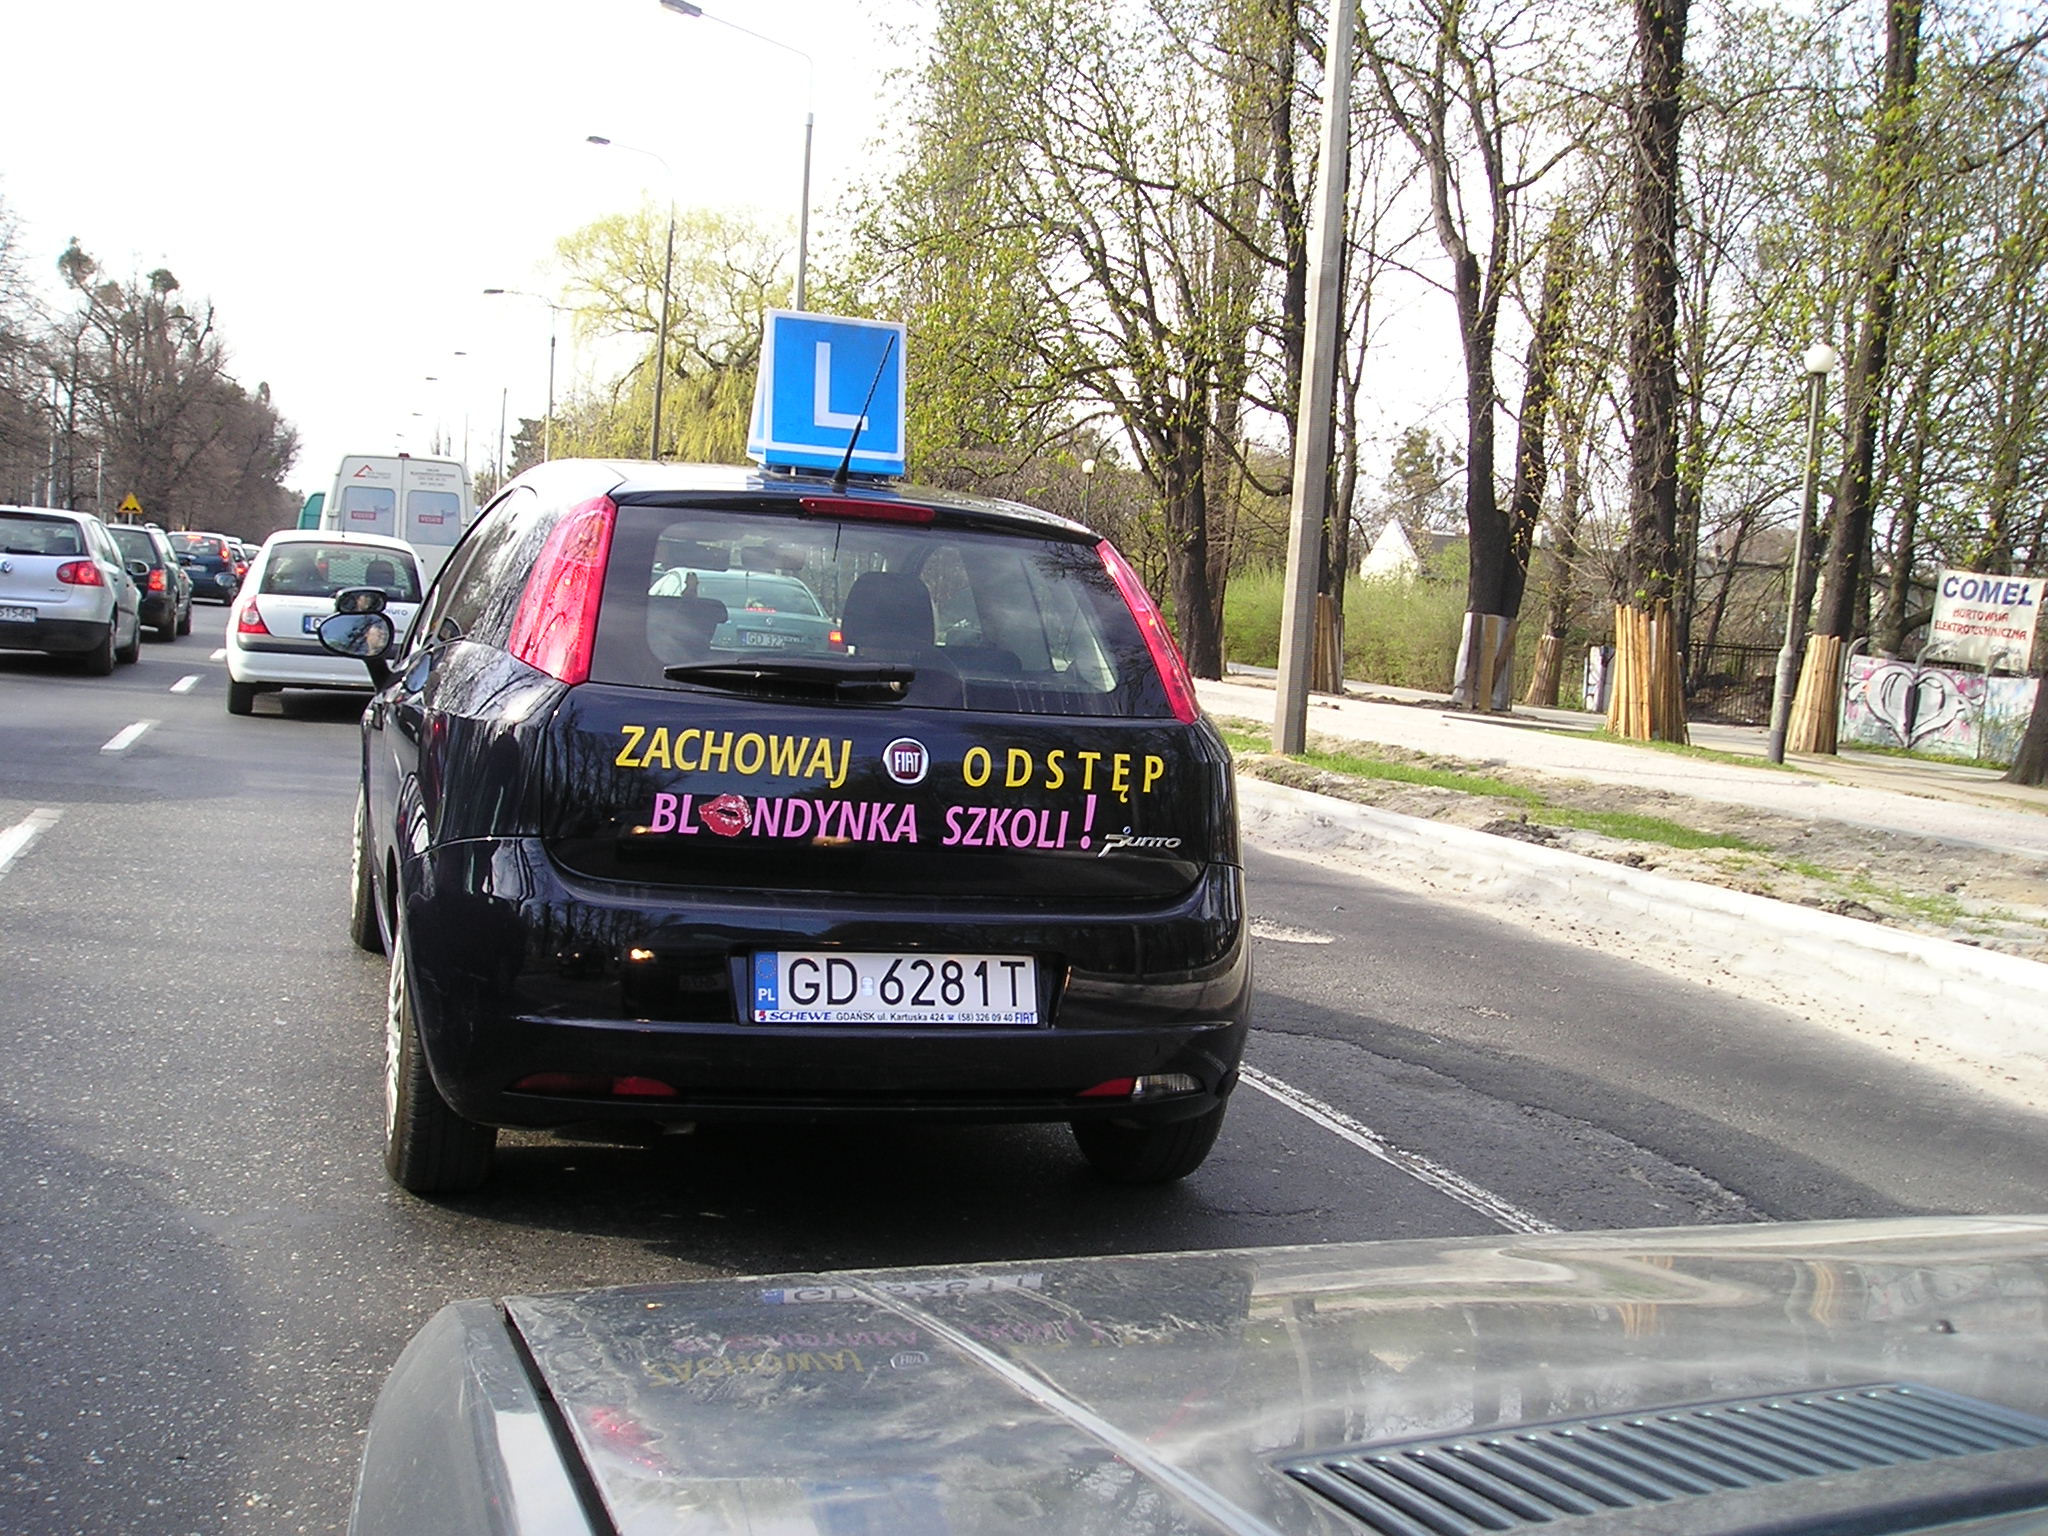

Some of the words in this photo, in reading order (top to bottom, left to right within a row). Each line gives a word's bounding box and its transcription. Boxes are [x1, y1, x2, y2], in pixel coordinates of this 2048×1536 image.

[814, 341, 869, 431] L
[1943, 576, 2032, 606] COMEL
[615, 725, 853, 788] ZACHOWAJ
[963, 747, 1165, 803] ODSTĘP
[894, 749, 920, 774] FIAT
[651, 792, 919, 843] BLNDYNKA
[758, 988, 776, 1001] PL
[788, 958, 858, 1006] GD
[879, 958, 1026, 1007] 6281T
[769, 1011, 832, 1021] SCHEWE
[890, 1012, 928, 1021] Kartuska
[930, 1012, 945, 1021] 424
[975, 1012, 990, 1021] 326
[1015, 1012, 1034, 1023] FIAT
